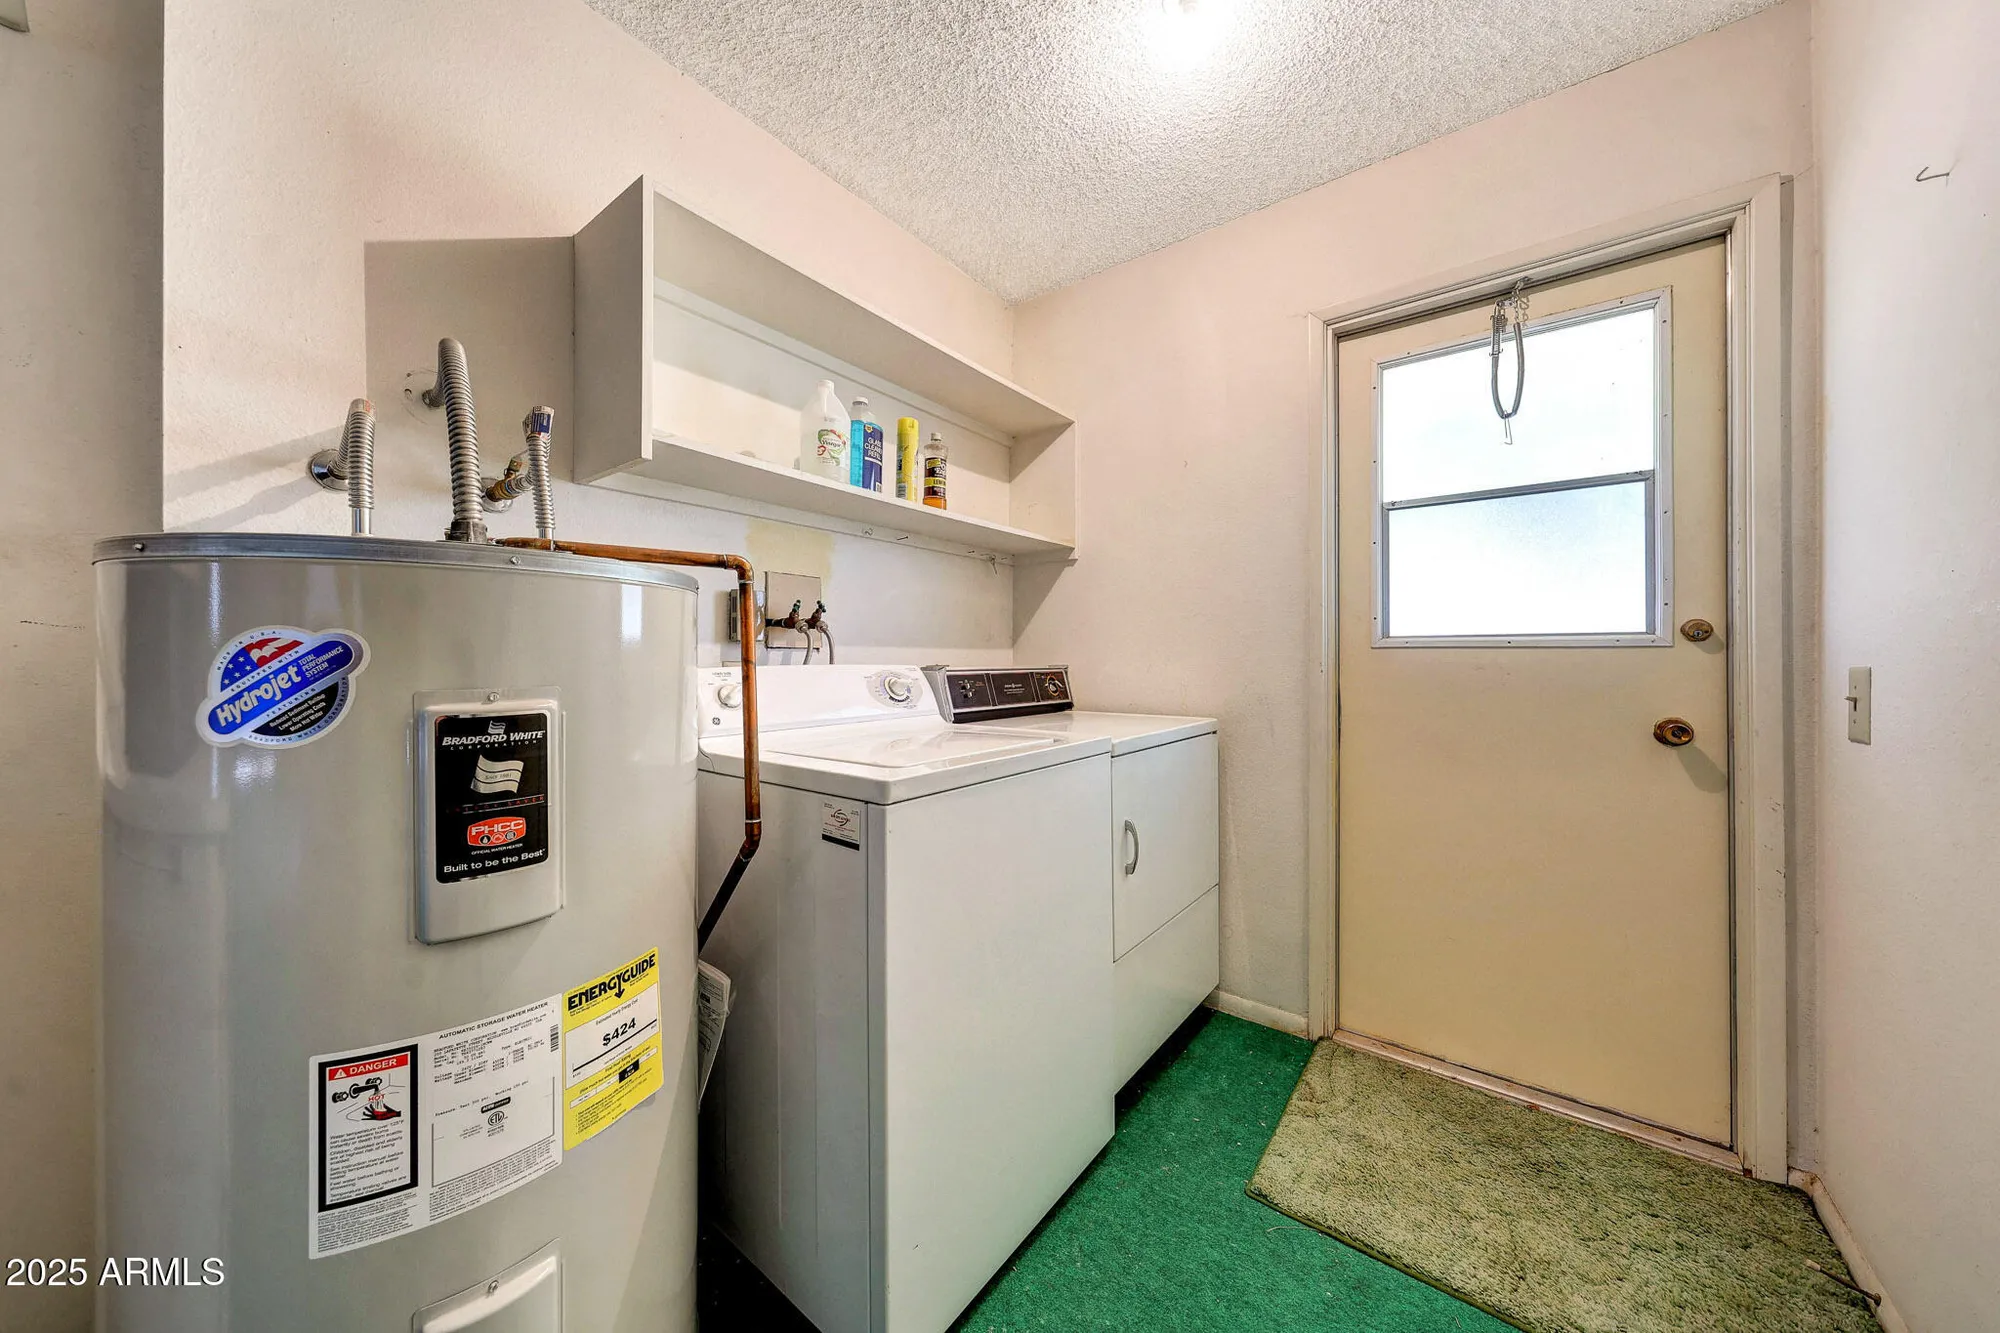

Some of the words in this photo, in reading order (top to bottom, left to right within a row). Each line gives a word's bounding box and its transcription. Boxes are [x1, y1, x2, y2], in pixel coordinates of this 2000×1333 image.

[298, 653, 316, 665] TOTAL
[302, 645, 344, 671] PERFORMANCE
[230, 665, 273, 692] EQUIPPED
[305, 661, 329, 678] SYSTEM
[216, 664, 301, 727] Hydrojet
[266, 688, 316, 717] FEATURING
[442, 734, 507, 746] BRADFORD
[509, 730, 544, 741] WHITE
[450, 740, 537, 751] CORPORATION
[471, 820, 524, 836] PHCC
[443, 863, 468, 873] Built
[485, 859, 499, 867] be
[502, 856, 519, 864] the
[521, 849, 544, 860] Best
[439, 1026, 476, 1039] AUTOMATIC
[476, 1017, 506, 1029] STORAGE
[506, 1010, 526, 1020] WATER
[526, 1002, 548, 1013] HEATER
[602, 1017, 636, 1046] $424
[349, 1059, 397, 1075] DANGER
[368, 1094, 385, 1102] HOT
